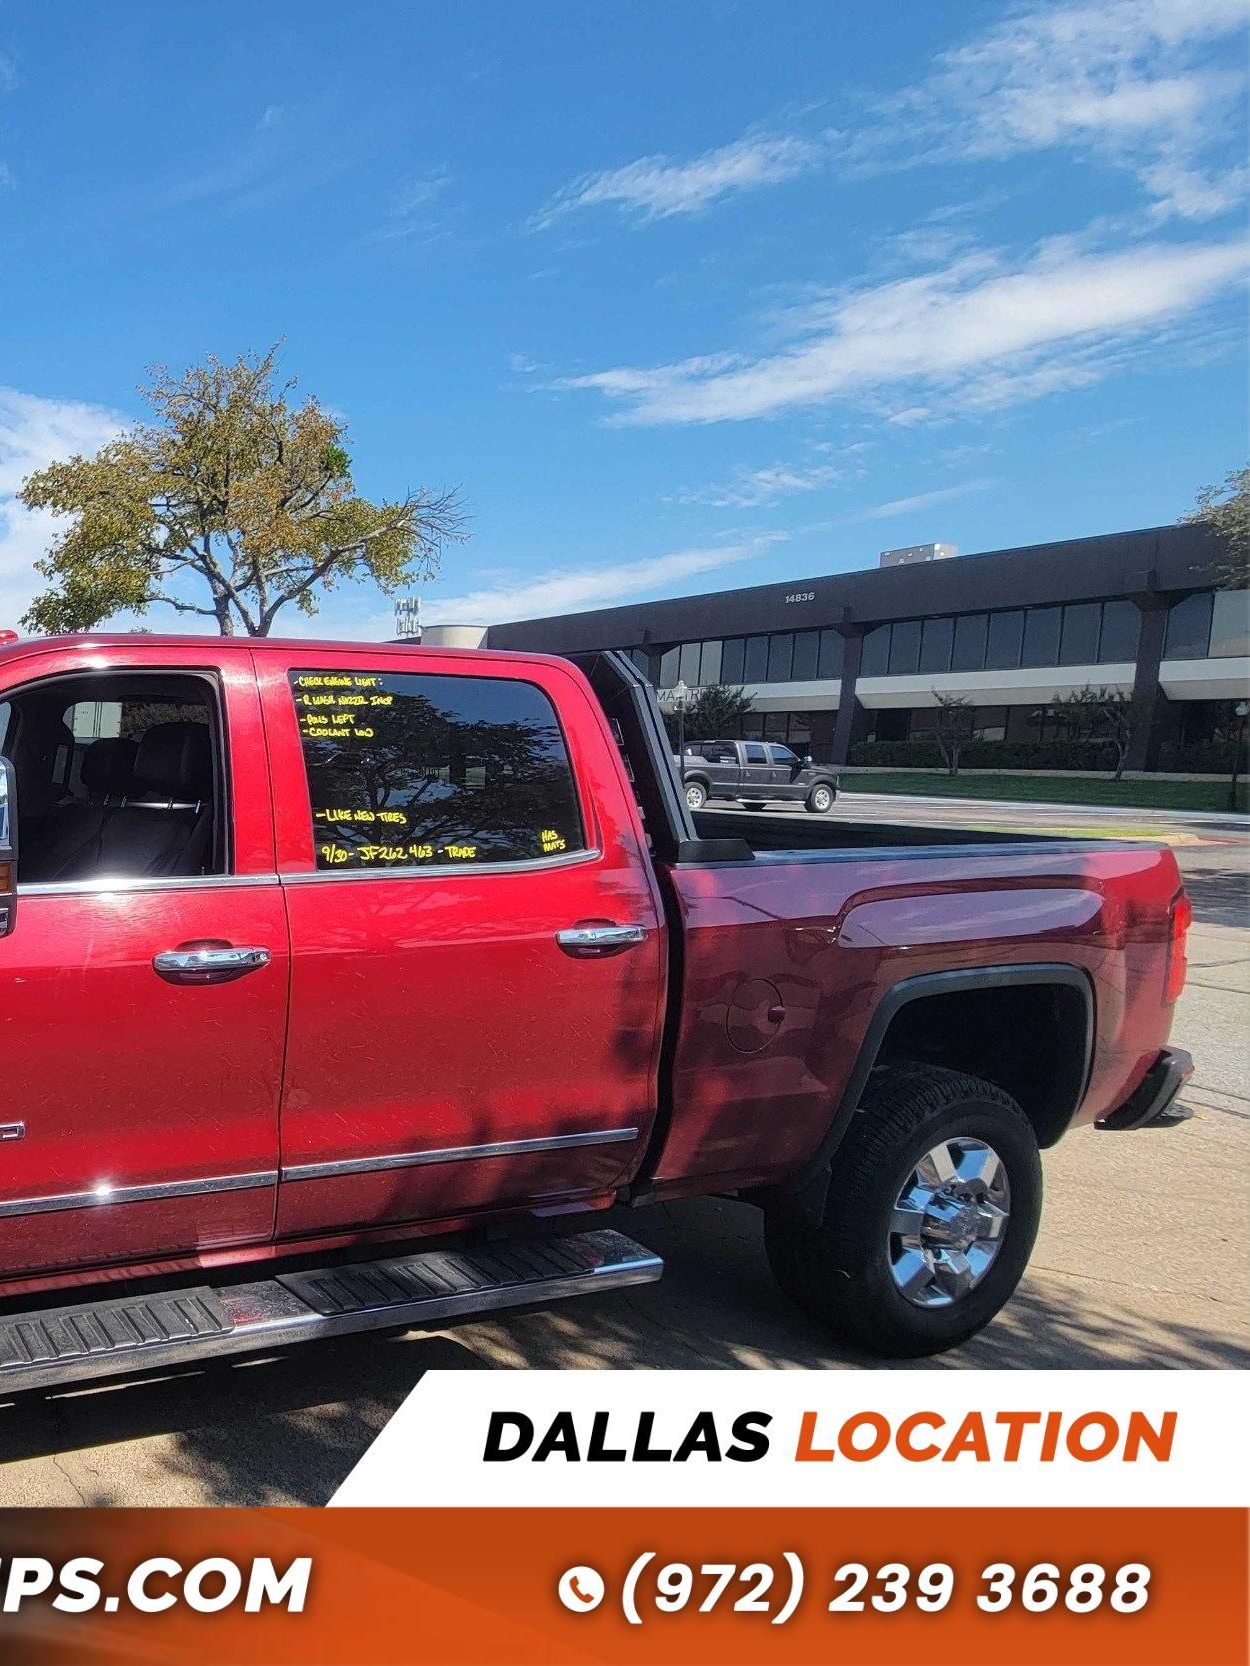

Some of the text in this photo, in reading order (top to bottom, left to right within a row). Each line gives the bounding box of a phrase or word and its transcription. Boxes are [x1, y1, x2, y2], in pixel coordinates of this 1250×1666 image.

[785, 592, 815, 603] 14836
[354, 810, 375, 822] NEW
[542, 830, 558, 842] HAS
[543, 839, 565, 852] MATS
